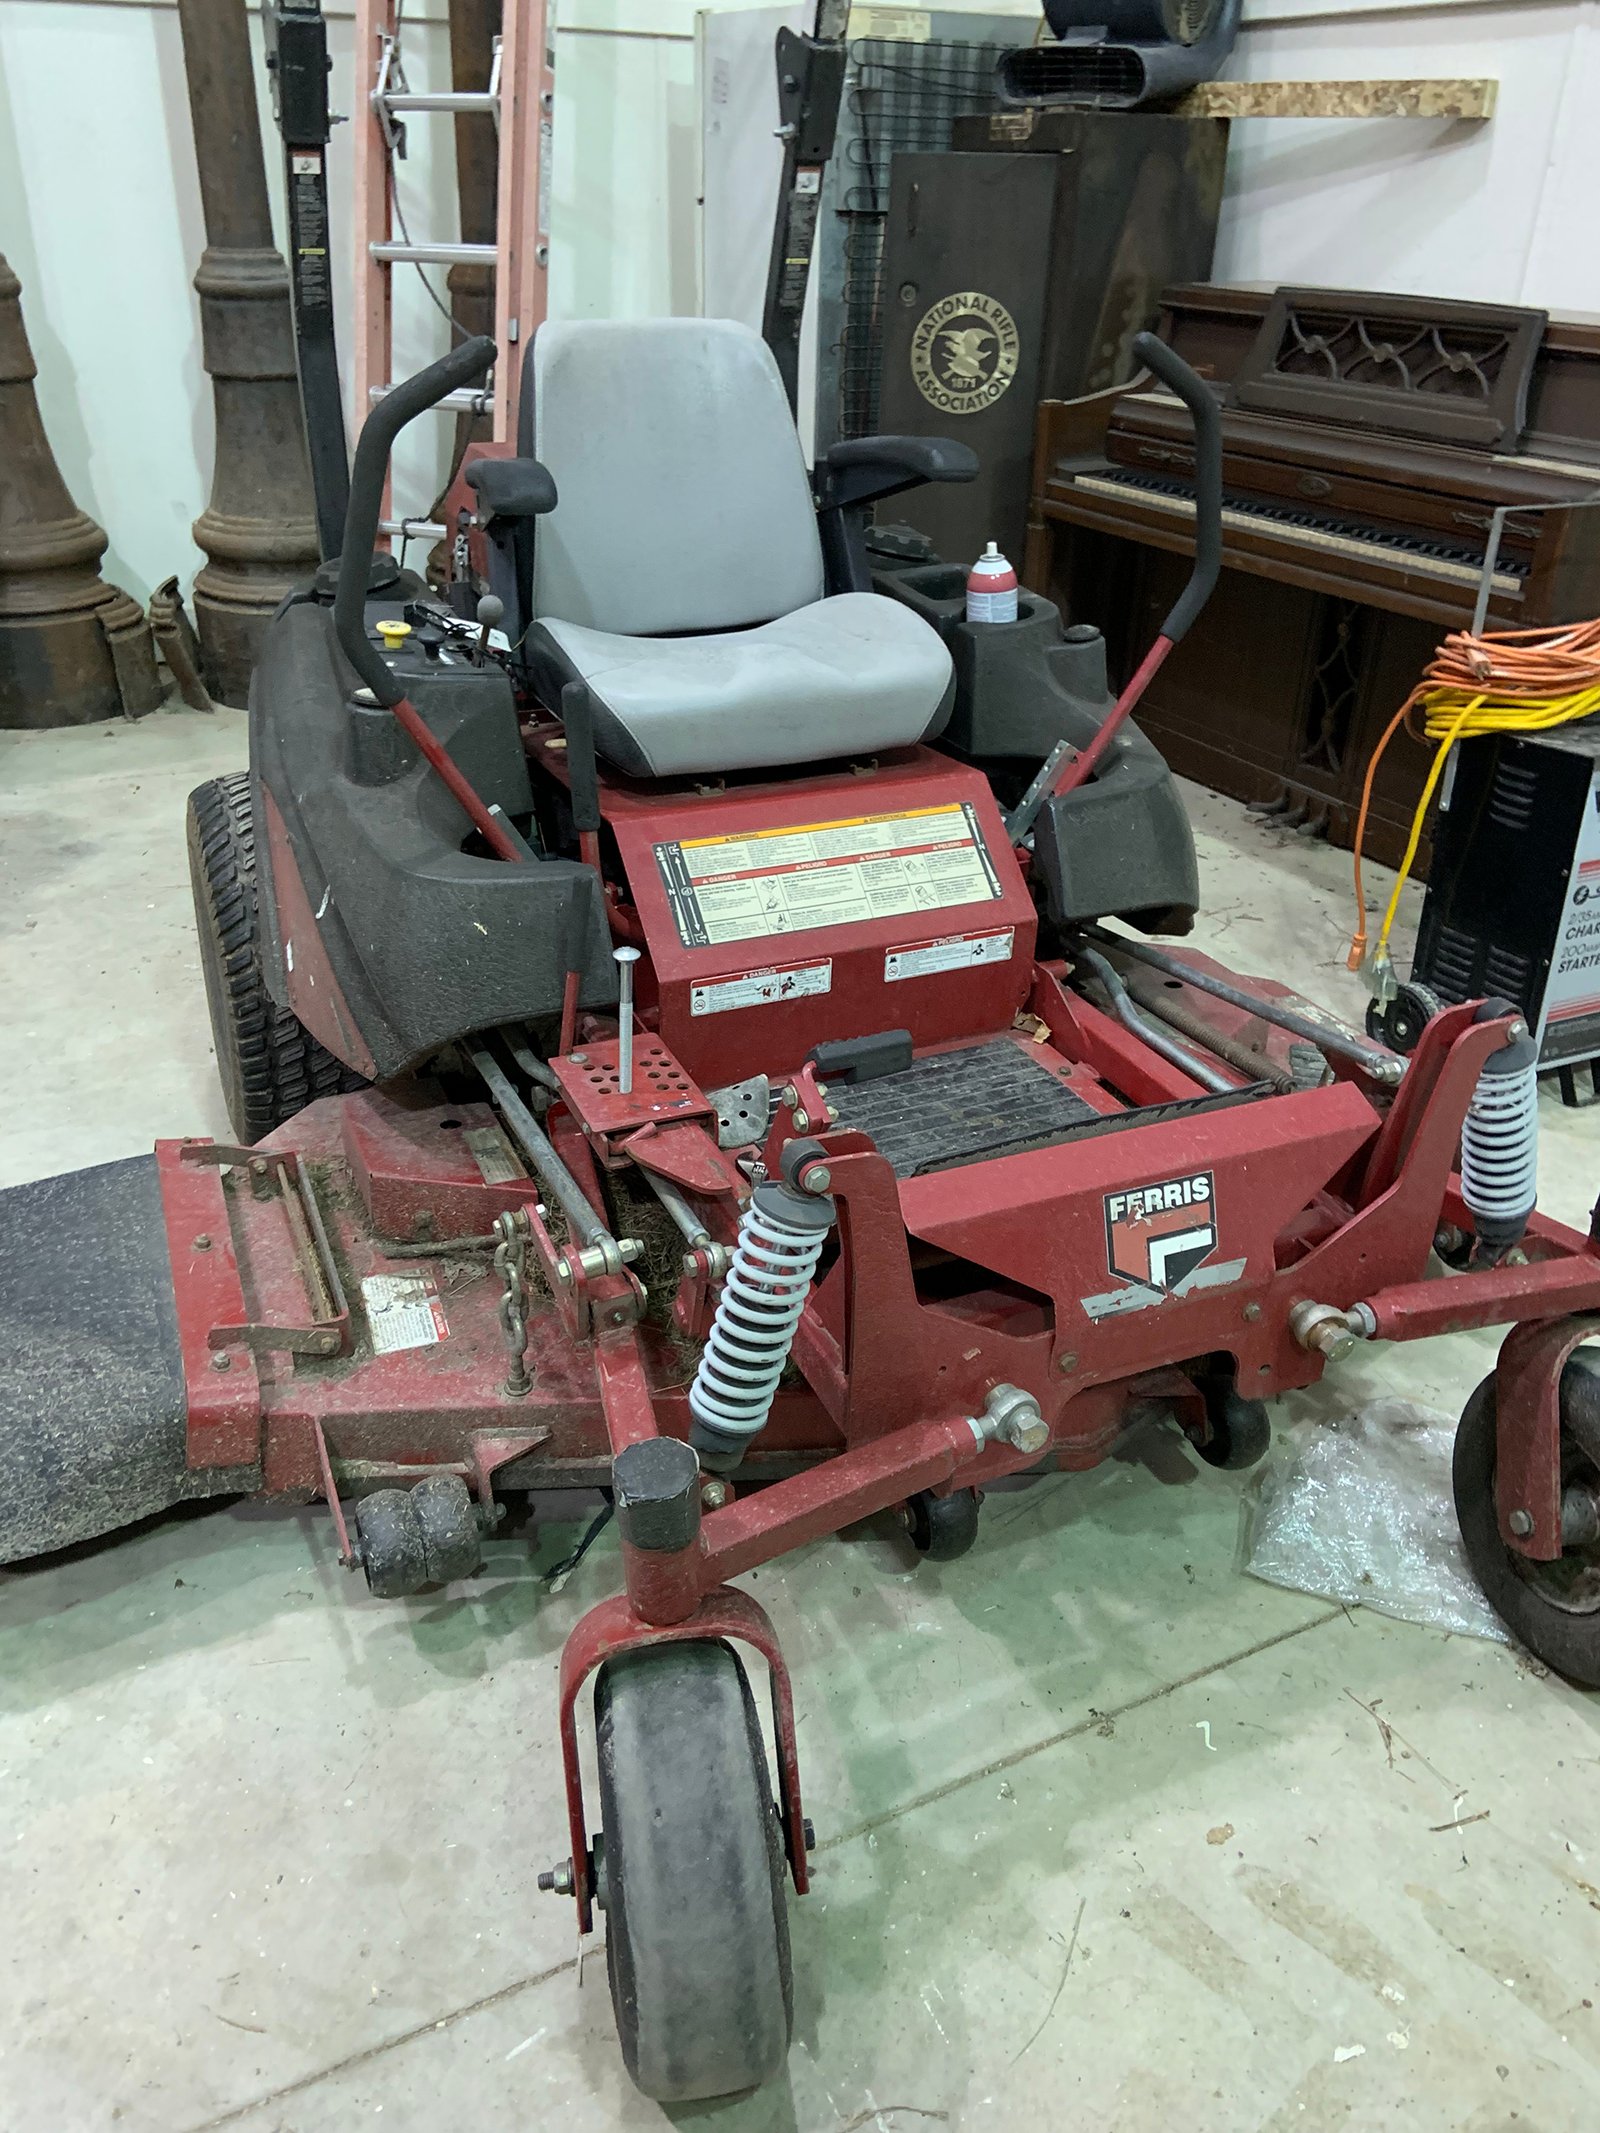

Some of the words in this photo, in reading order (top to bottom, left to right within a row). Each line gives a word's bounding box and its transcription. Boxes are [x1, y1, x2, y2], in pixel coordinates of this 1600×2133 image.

[915, 296, 989, 351] NATIONAL
[990, 307, 1016, 351] RIFLE
[915, 371, 1011, 411] ASSOCIATION
[800, 861, 828, 870] PELIGRO
[709, 874, 737, 883] DANGER
[749, 968, 777, 978] DANGER
[1109, 1176, 1210, 1221] FERRIS
